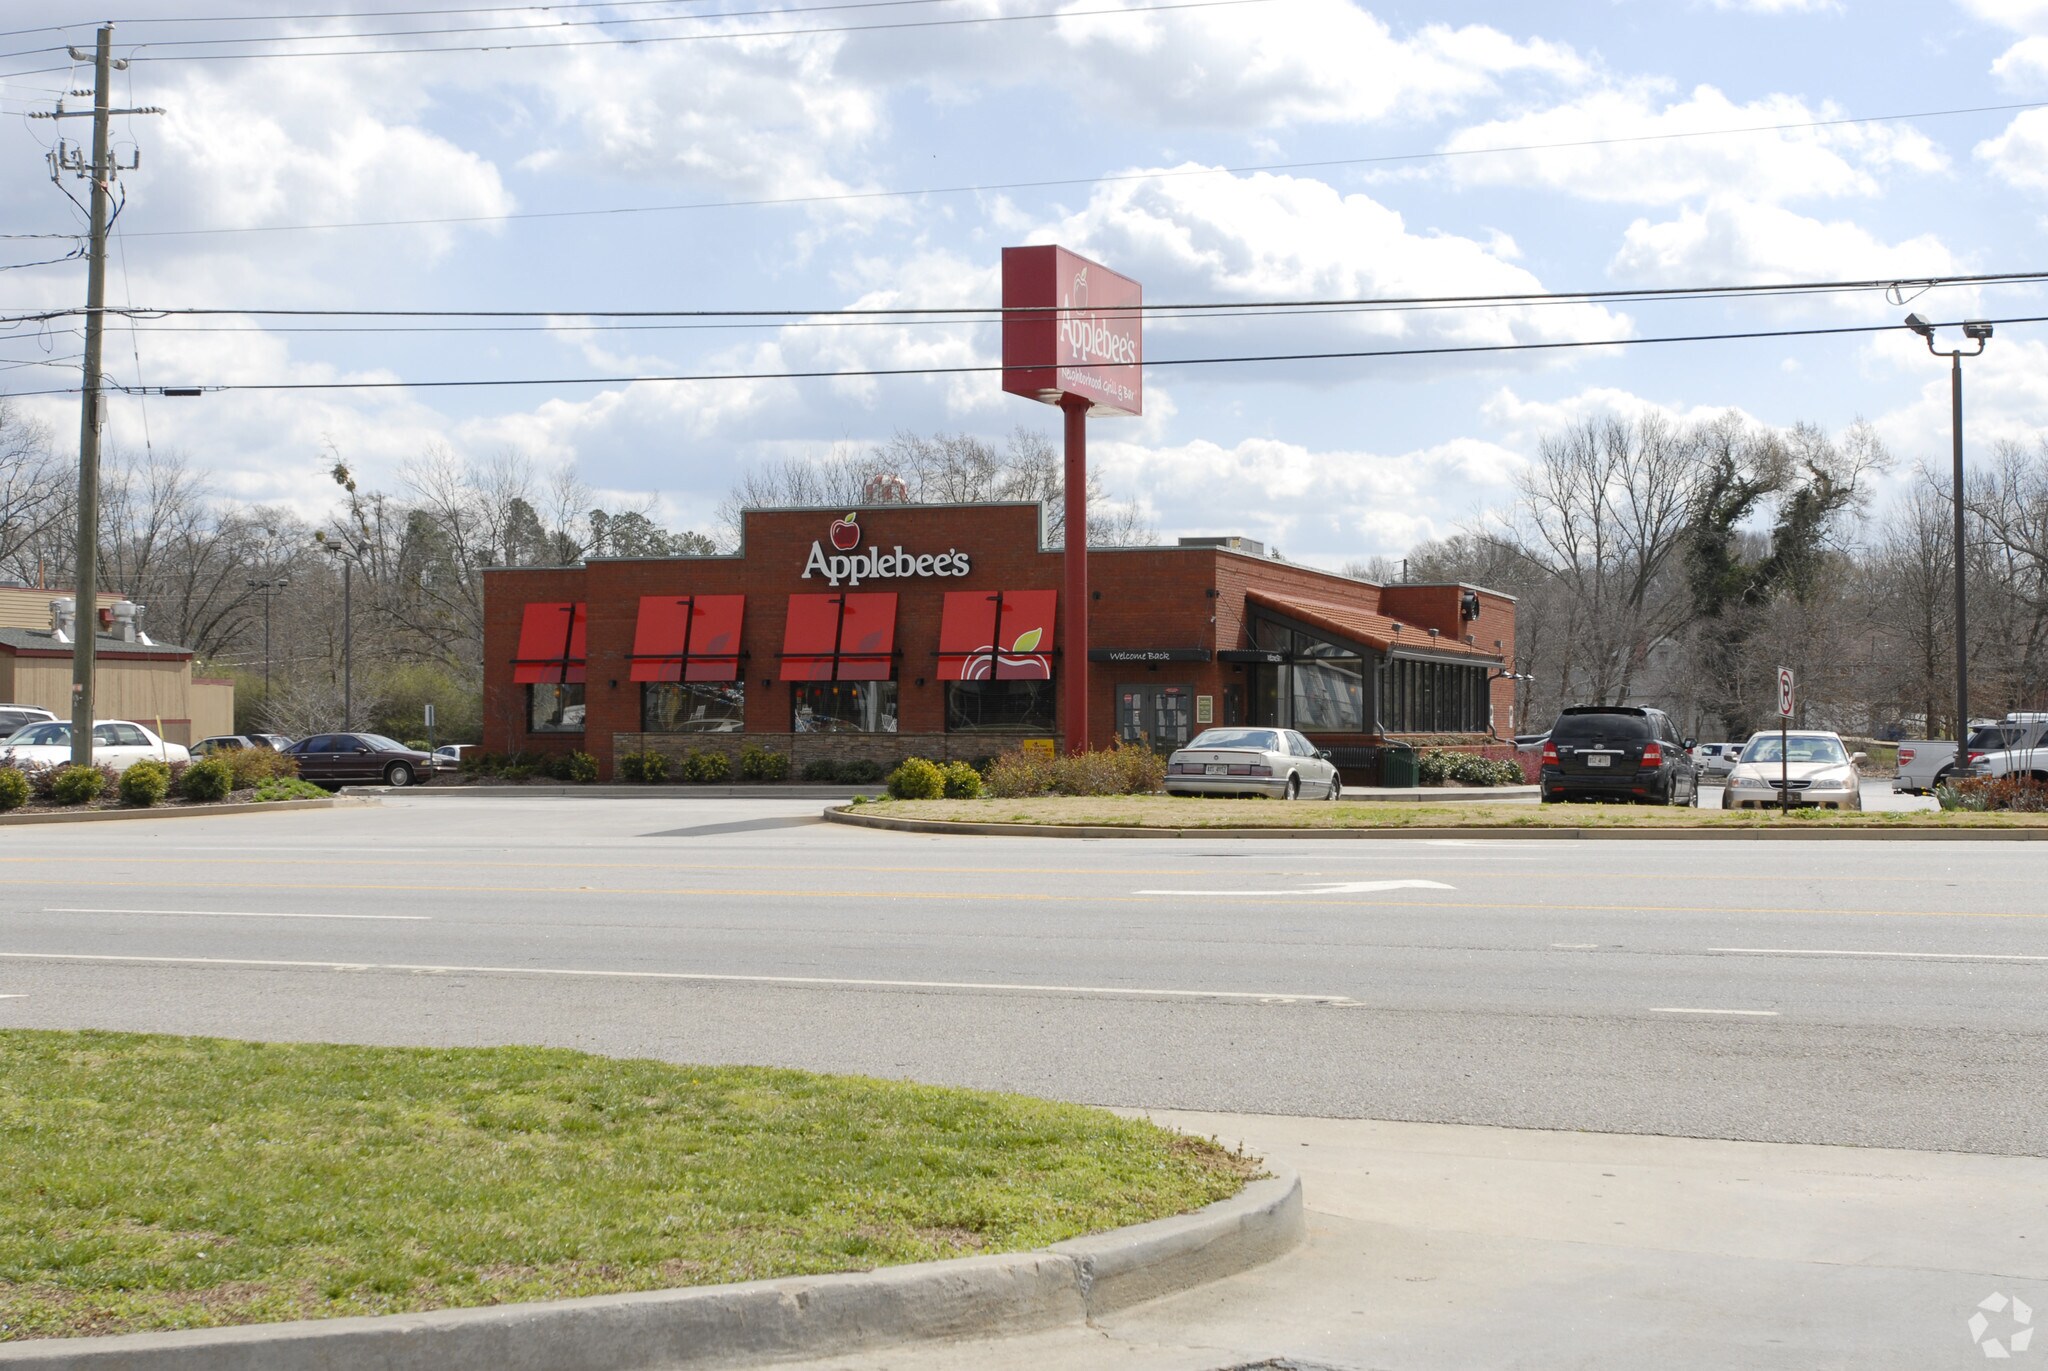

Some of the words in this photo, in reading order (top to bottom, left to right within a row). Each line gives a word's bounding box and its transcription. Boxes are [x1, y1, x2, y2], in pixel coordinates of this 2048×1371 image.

[1060, 293, 1136, 368] Applebee's
[1061, 366, 1102, 387] Neighborhood
[1103, 379, 1117, 395] Grill
[1123, 386, 1134, 400] Bar
[801, 540, 970, 586] Applebee's
[1109, 651, 1147, 660] Welcome
[1147, 651, 1170, 660] Back
